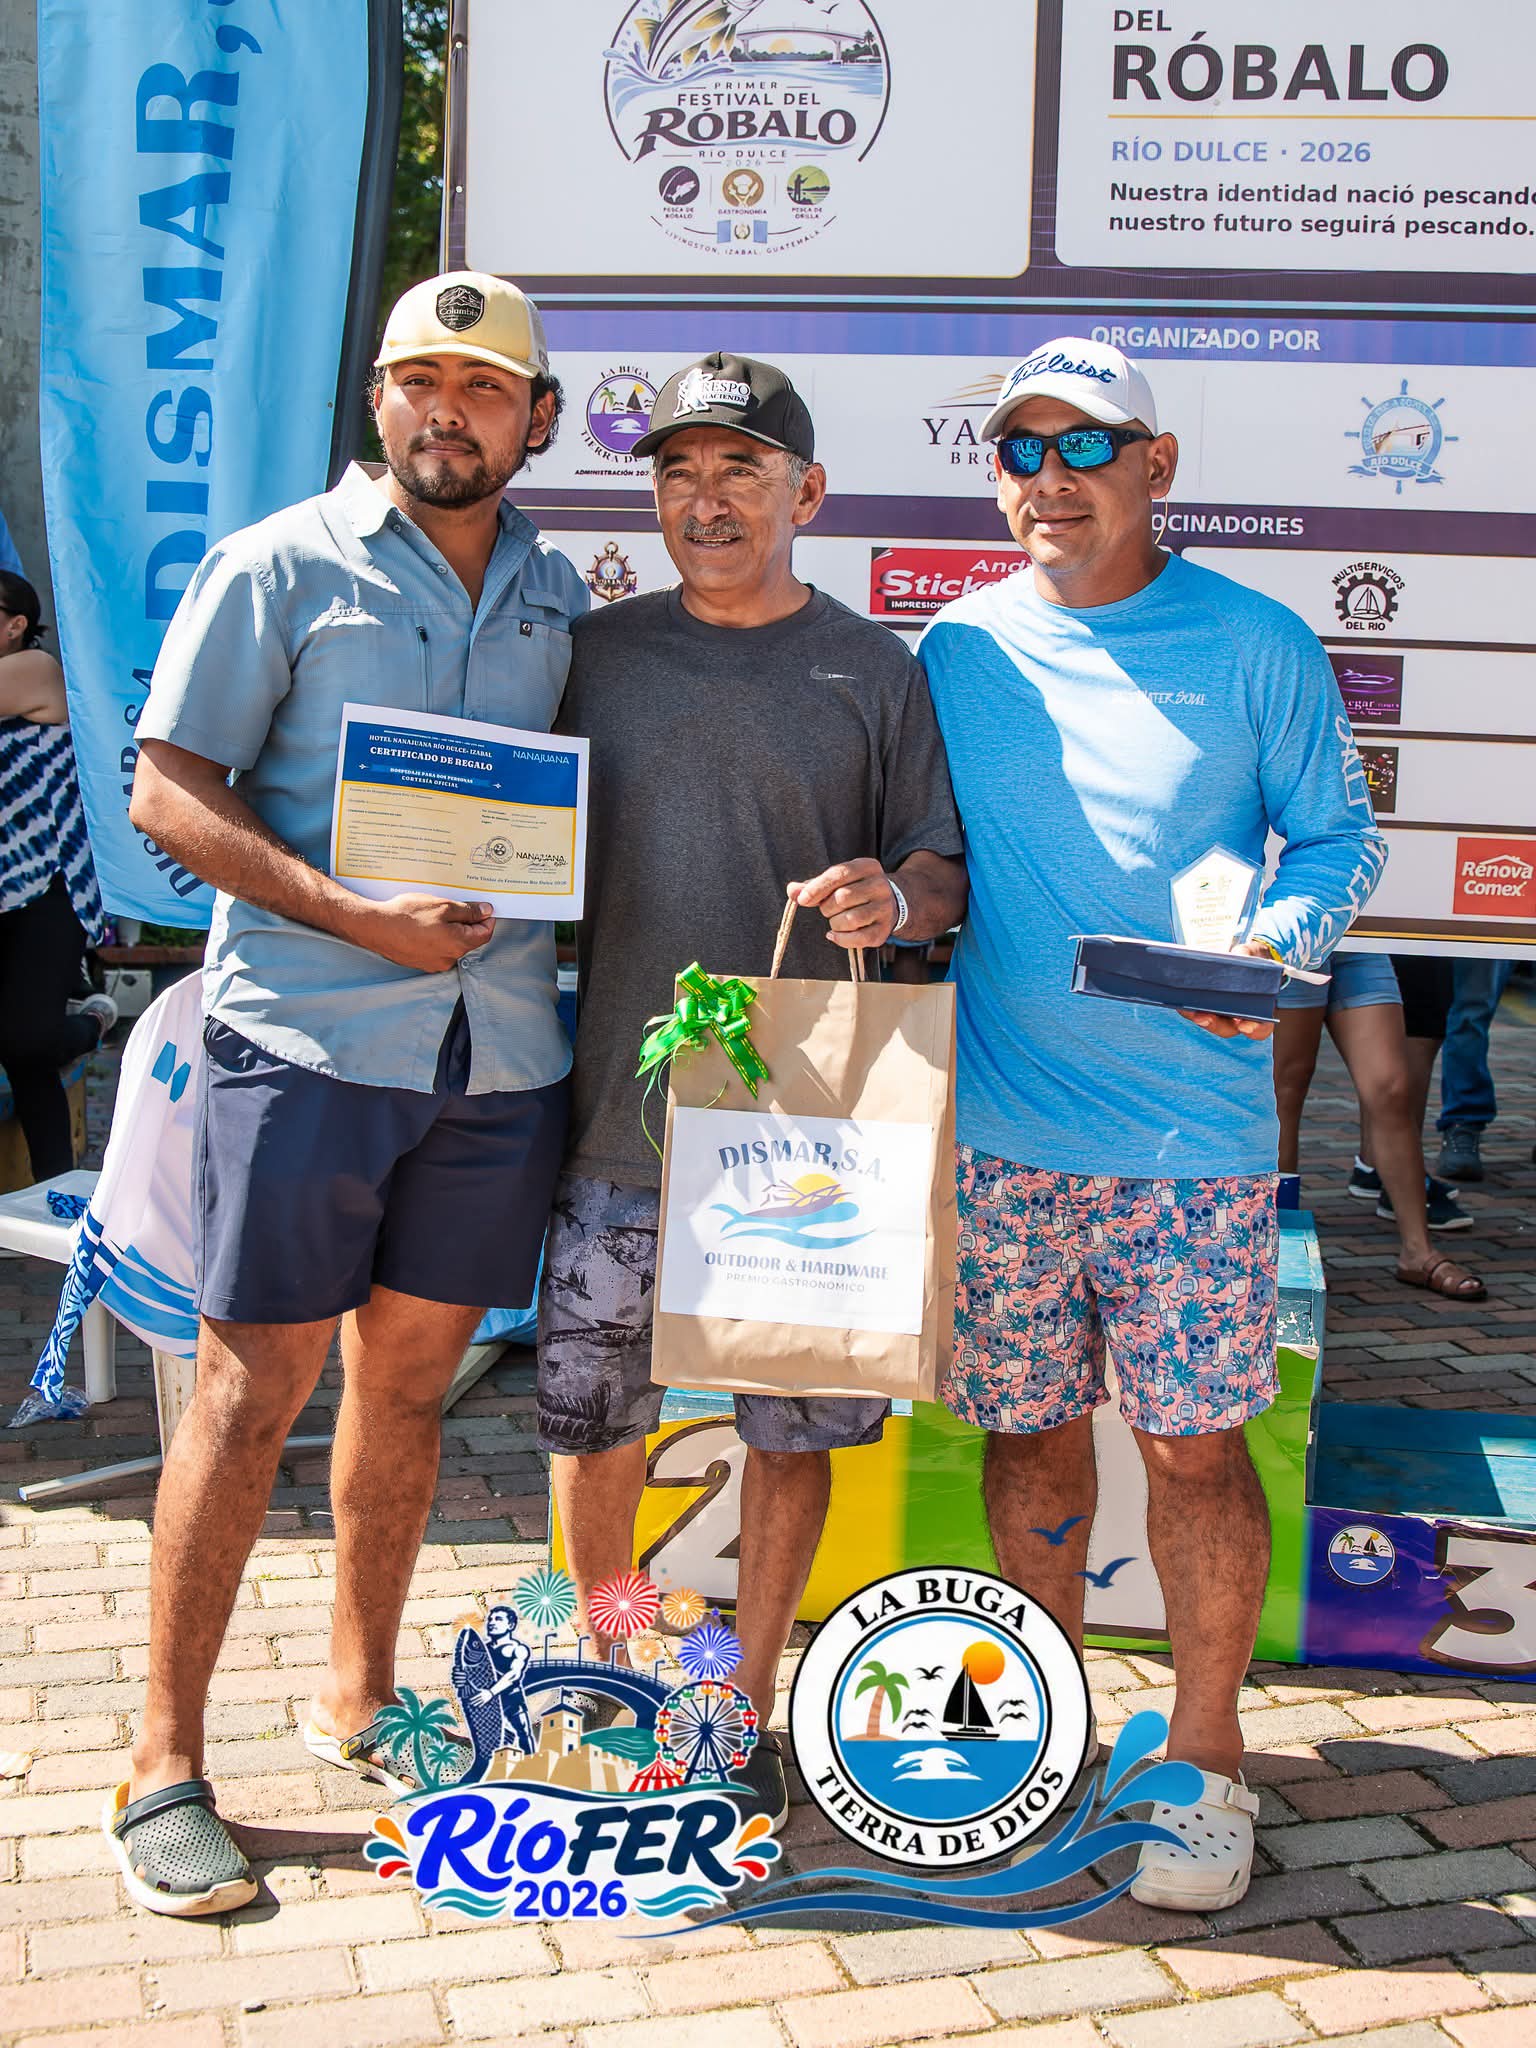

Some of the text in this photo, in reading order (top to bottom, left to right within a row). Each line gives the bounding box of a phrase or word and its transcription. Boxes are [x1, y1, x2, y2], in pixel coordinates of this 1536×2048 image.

[1114, 9, 1172, 32] DEL
[1112, 31, 1450, 102] RÓBALO
[714, 81, 778, 90] PRIMER
[677, 92, 821, 106] FESTIVAL DEL
[633, 107, 857, 164] RÓBALO
[736, 149, 787, 158] DULCE
[1111, 136, 1371, 163] RÍO DULCE 2026
[1110, 183, 1208, 203] Nuestra
[1218, 183, 1337, 204] identidad
[1346, 183, 1414, 204] nació
[1109, 213, 1535, 238] nuestro futuro seguirá pescando.
[766, 230, 820, 254] GUATEMALA
[439, 306, 479, 317] Columbia
[1091, 326, 1321, 351] ORGANIZADO POR
[600, 365, 649, 379] LA BUGA
[1002, 351, 1117, 399] Titleist
[580, 430, 619, 463] TIERRA
[1331, 561, 1406, 591] MULTISERVICIOS
[1345, 621, 1386, 631] DEL RIO
[369, 734, 392, 743] HOTEL
[392, 736, 432, 749] NANAJUANA
[432, 742, 445, 750] RÍO
[469, 748, 493, 759] IZABAL
[512, 749, 570, 765] NANAJUANA
[369, 746, 494, 772] CERTIFICADO DE REGALO
[401, 775, 459, 789] CORTESÍA OFICIAL
[1461, 860, 1534, 879] Renova
[1463, 880, 1528, 897] Comex
[704, 1251, 889, 1281] OUTDOOR & HARDWARE
[726, 1272, 866, 1293] PREMIO GASTRONOMICO
[1424, 1530, 1536, 1670] 3
